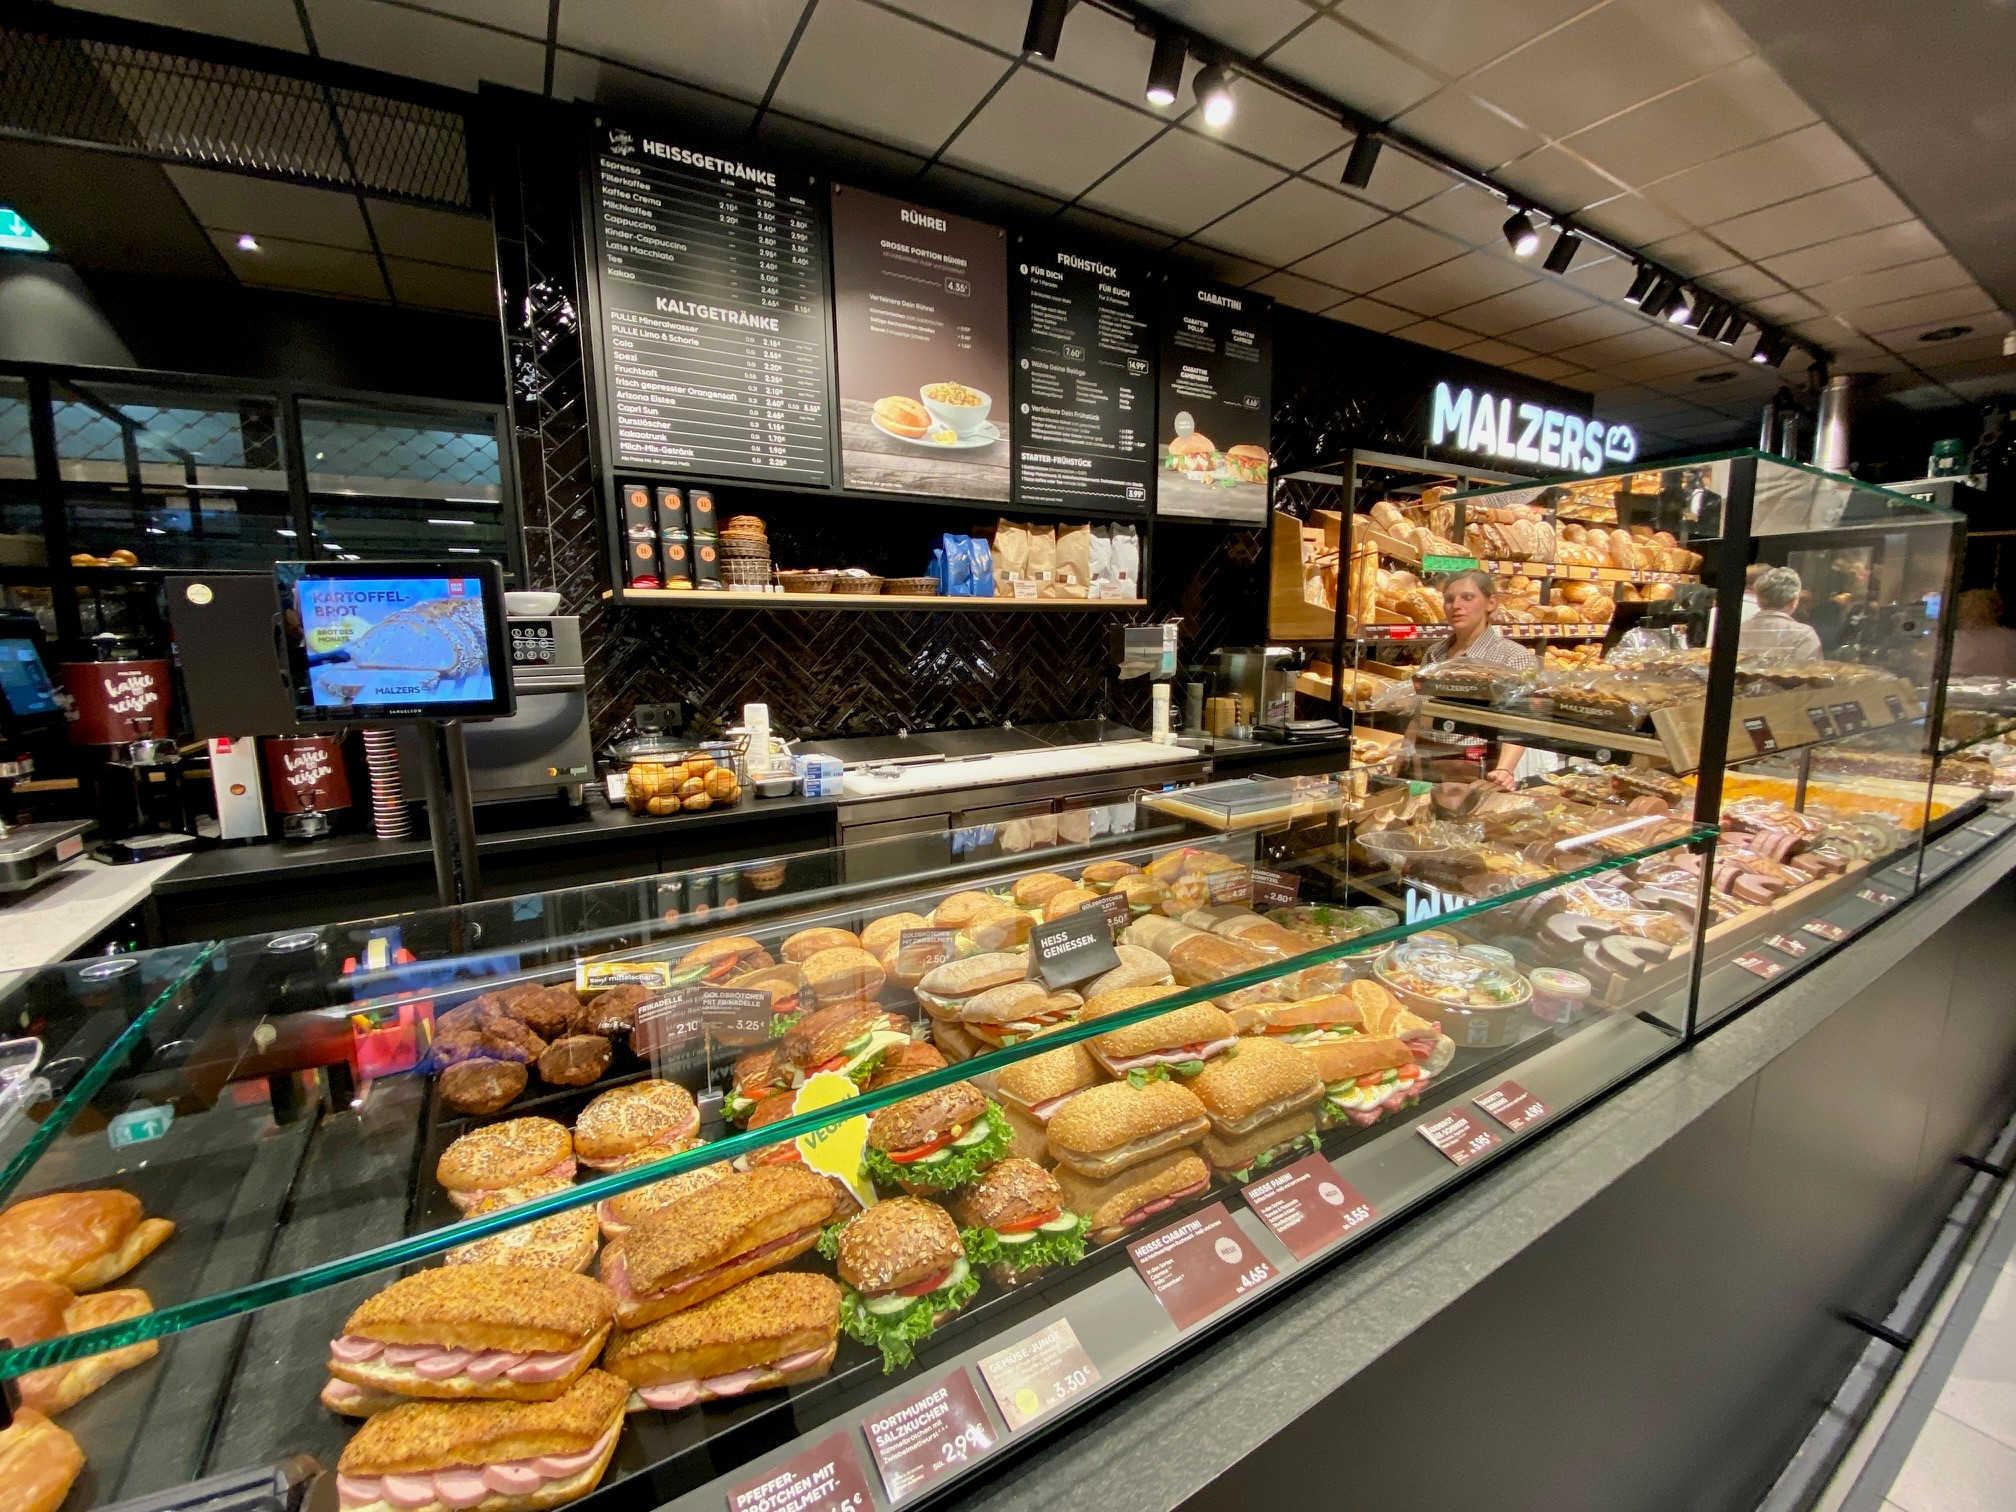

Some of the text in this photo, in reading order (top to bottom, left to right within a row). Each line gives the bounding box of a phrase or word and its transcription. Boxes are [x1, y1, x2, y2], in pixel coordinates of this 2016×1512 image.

[600, 158, 641, 175] Espresso
[643, 138, 776, 187] HEISSGETRÄNKE
[601, 172, 650, 190] Filterkaffee
[602, 185, 631, 199] Kaffee
[632, 193, 662, 206] Crema
[602, 200, 653, 218] Milchkaffee
[603, 213, 657, 231] Cappuccino
[900, 208, 948, 233] RÜHREI
[605, 227, 687, 251] Kinder-Cappuccino
[606, 240, 629, 252] Latte
[630, 245, 675, 261] Macchiato
[607, 253, 623, 264] Tee
[880, 239, 911, 254] GROSSE
[911, 247, 943, 262] PORTION
[943, 255, 968, 268] RÜHREI
[608, 267, 636, 280] Kakao
[1030, 265, 1064, 281] FÜR DICH
[1057, 252, 1118, 279] FRÜHSTÜCK
[1098, 283, 1131, 299] FÜR EUCH
[1197, 290, 1242, 311] CIABATTINI
[610, 310, 638, 323] PULLE
[638, 316, 699, 334] Mineralwasser
[656, 296, 779, 332] KALTGETRÄNKE
[611, 324, 639, 336] PULLE
[640, 329, 661, 340] Limo
[669, 335, 700, 347] Schorle
[613, 350, 639, 363] Spezi
[614, 364, 659, 378] Fruchtsaft
[615, 376, 640, 388] frisch
[641, 381, 687, 395] gepresster
[687, 387, 739, 401] Orangensaft
[616, 390, 649, 402] Arizona
[650, 394, 677, 405] Eistee
[617, 403, 642, 414] Capri
[642, 406, 660, 415] Sun
[618, 416, 672, 429] Durstlöscher
[1432, 381, 1604, 474] MALZERS
[619, 429, 669, 441] Kakaotrunk
[620, 441, 696, 457] Milch-Mix-Getränk
[1021, 452, 1093, 468] STARTER-FRÜHSTÜCK
[312, 590, 411, 604] KARTOFFEL-
[314, 604, 358, 617] BROT
[375, 685, 421, 695] MALZERS
[1040, 931, 1069, 949] HEISS
[1043, 933, 1097, 959] GENIESSEN.
[638, 995, 683, 1014] FRIKADELLE
[1134, 1238, 1164, 1258] HEISSE
[871, 1388, 949, 1435] DORTMUNDER
[876, 1402, 950, 1448] SALZKUCHEN
[811, 1461, 835, 1484] MIT
[736, 1471, 798, 1508] PFEFFER-
